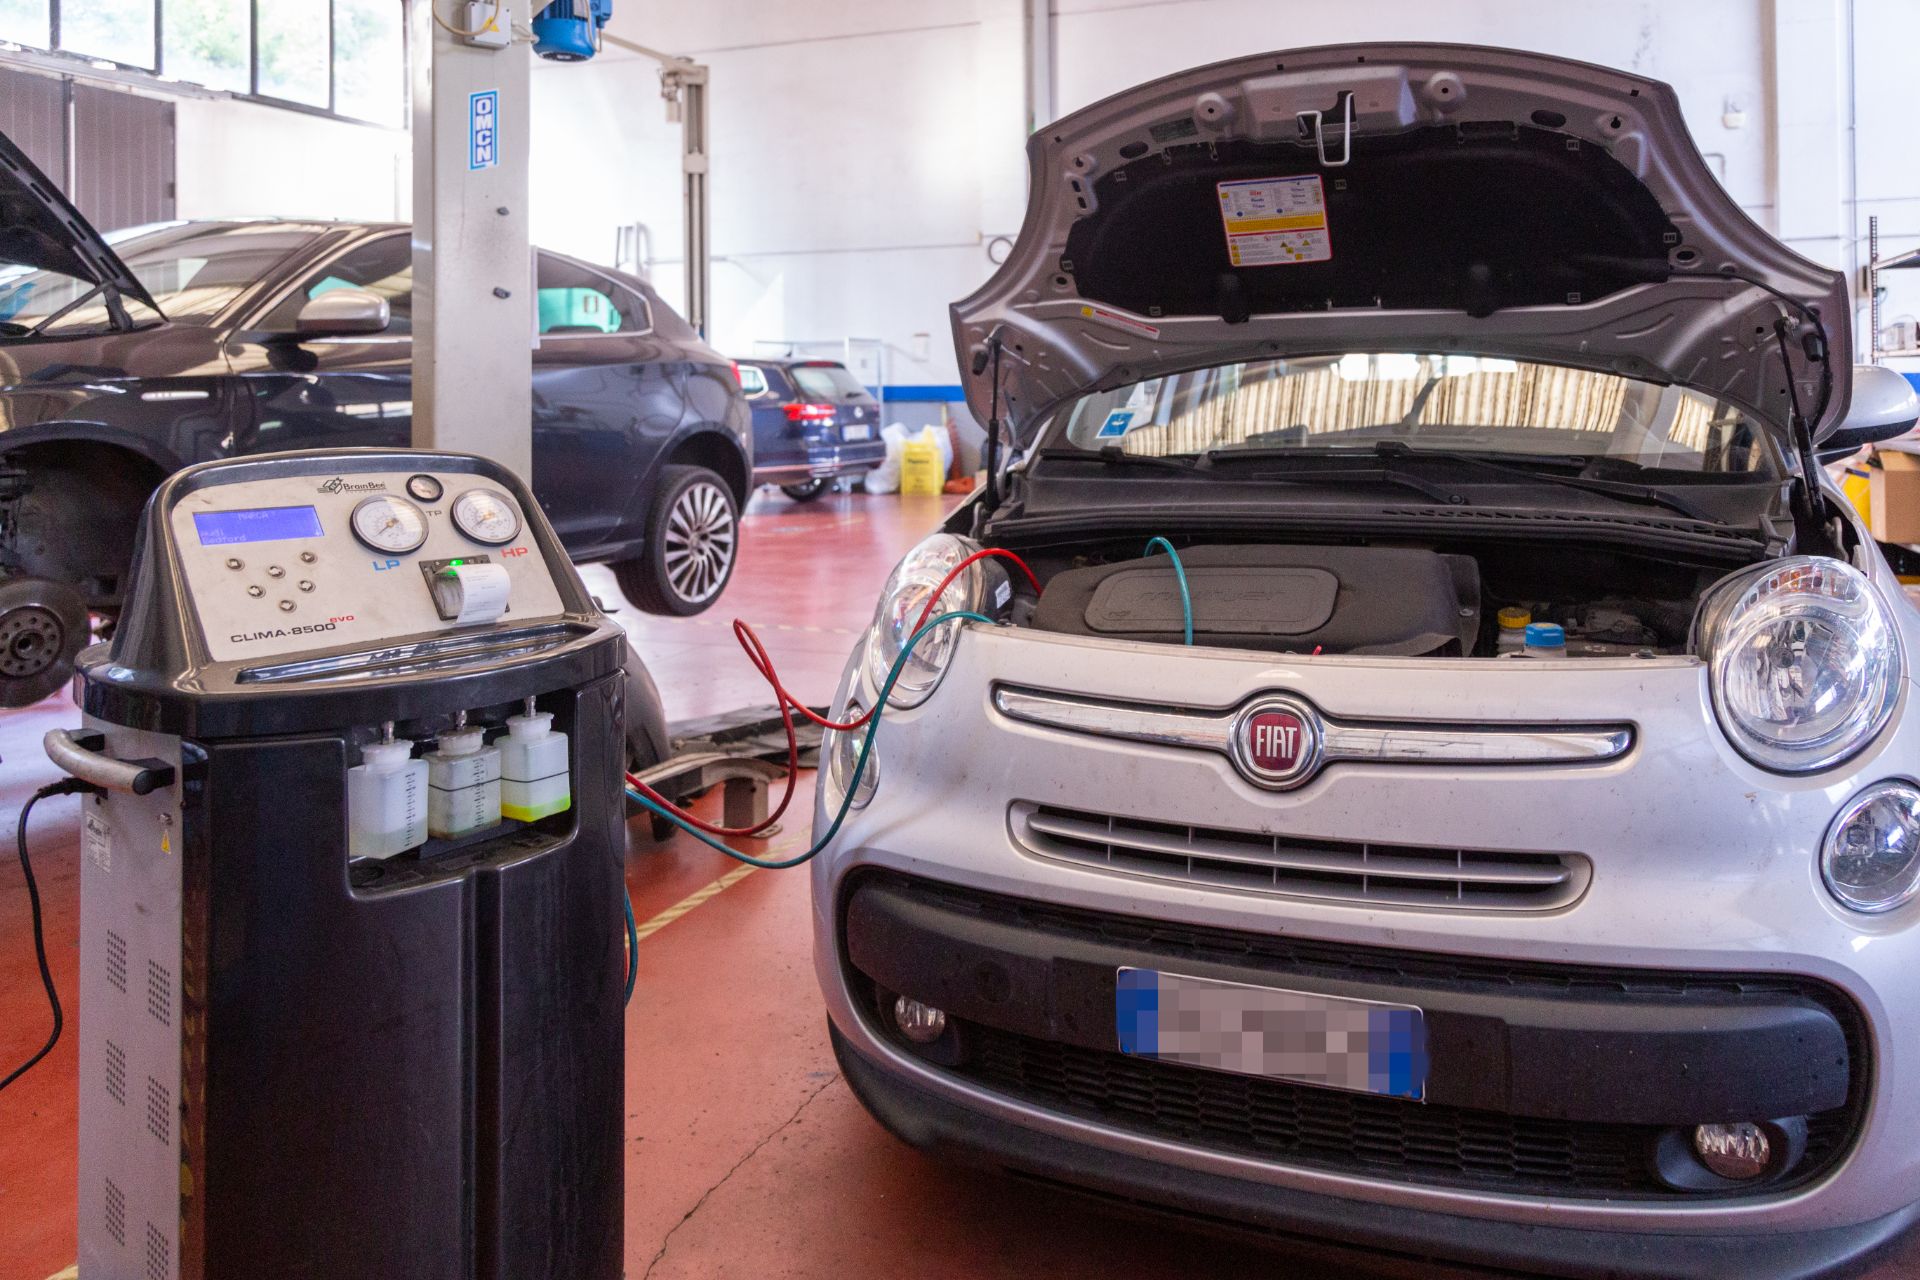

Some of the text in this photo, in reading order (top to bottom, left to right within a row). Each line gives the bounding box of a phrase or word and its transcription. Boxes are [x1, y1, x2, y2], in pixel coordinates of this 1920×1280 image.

[476, 97, 493, 163] OMCN
[343, 481, 386, 491] BrainBee
[501, 547, 528, 559] HP
[373, 559, 400, 572] LP
[329, 615, 355, 624] evo
[1256, 724, 1298, 759] FIAT
